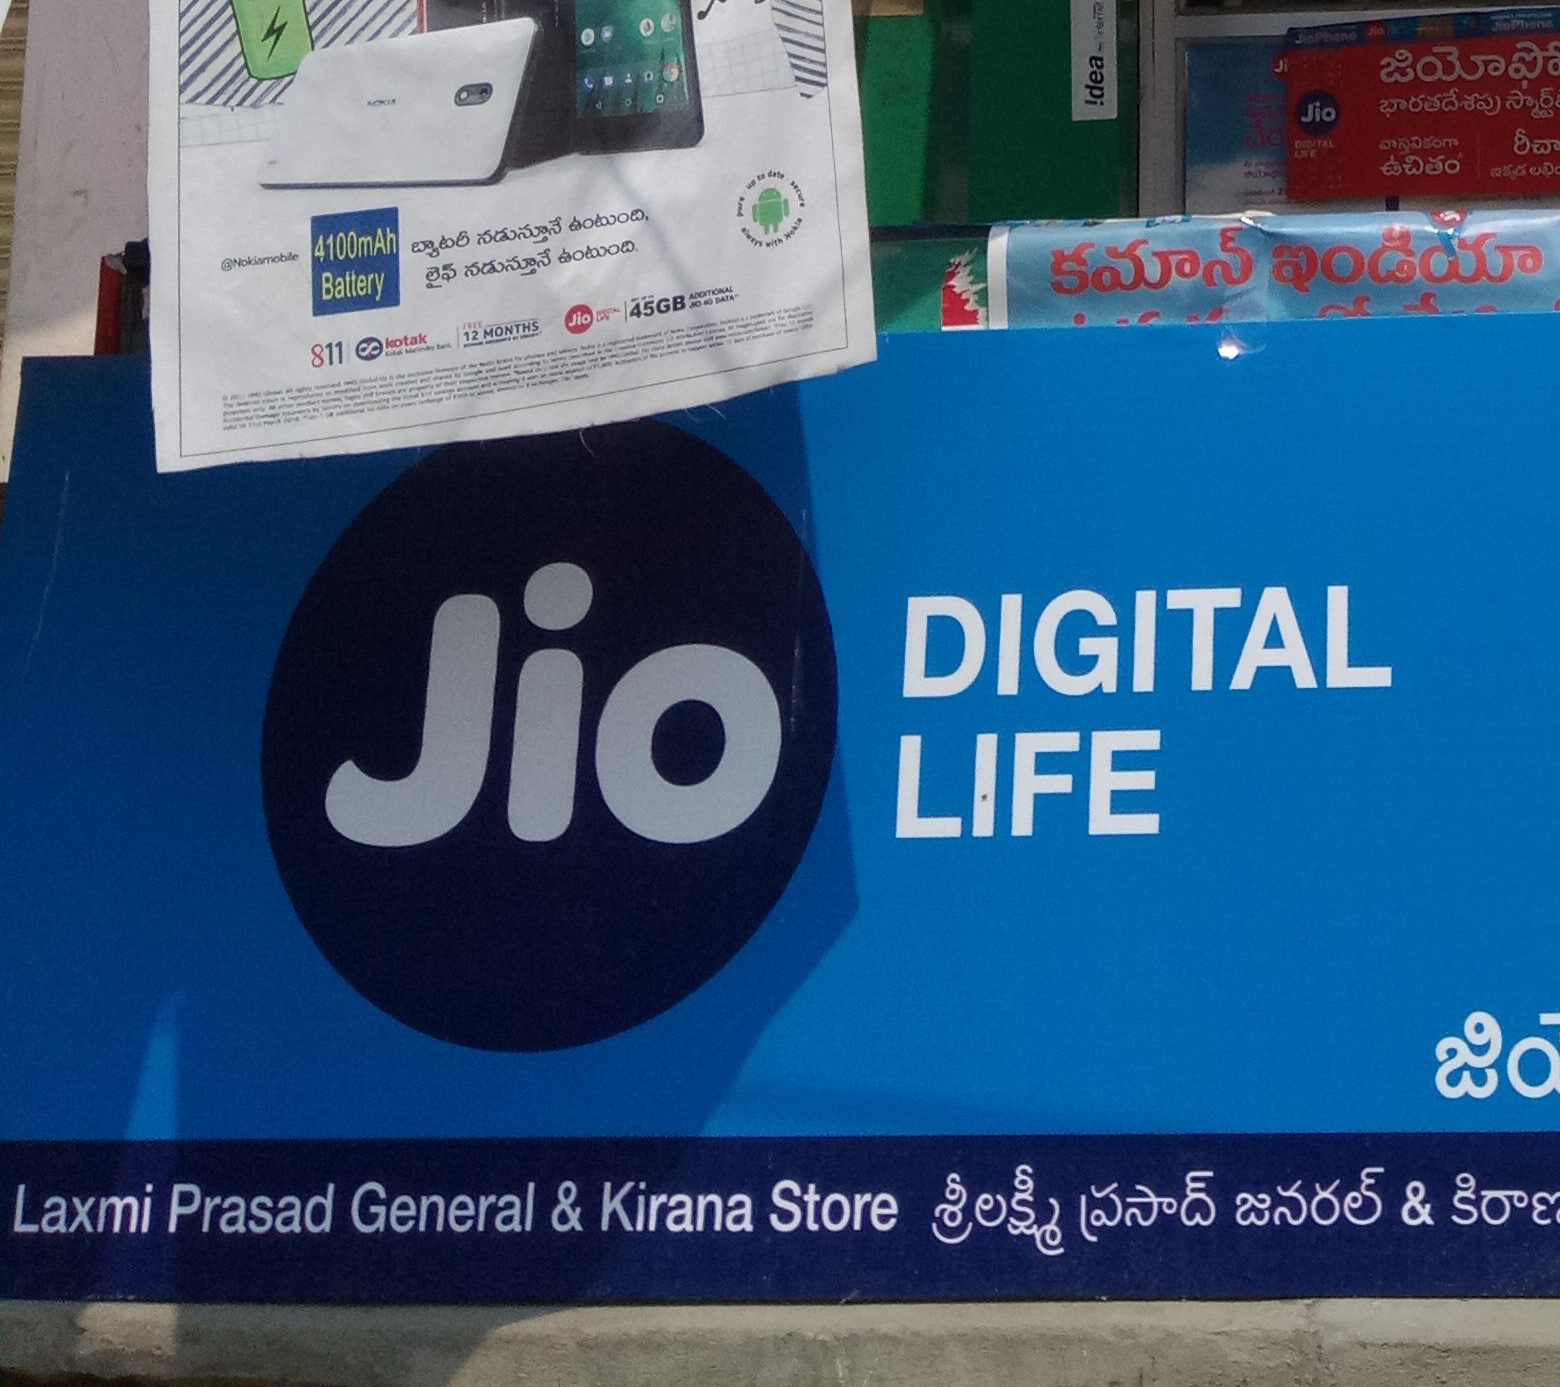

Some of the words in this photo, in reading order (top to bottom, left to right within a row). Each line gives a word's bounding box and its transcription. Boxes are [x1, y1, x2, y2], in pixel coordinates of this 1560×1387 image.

[1299, 104, 1336, 126] Jio
[1378, 87, 1501, 117] భారతదేశపు
[767, 168, 785, 180] date
[312, 226, 398, 263] 4100mAh
[1049, 226, 1256, 297] కమాన్
[1271, 223, 1546, 294] ఇండియా
[321, 270, 386, 303] Battery
[688, 285, 735, 301] ADDITIONAL
[567, 311, 592, 328] Jio
[628, 295, 687, 320] 45GB
[385, 332, 428, 350] kotak
[462, 329, 480, 343] 12
[482, 319, 540, 341] MONTHS
[310, 340, 344, 369] 811
[901, 583, 1394, 699] DIGITAL
[324, 560, 783, 848] Jio
[894, 727, 1163, 839] LIFE
[13, 1181, 154, 1235] Laxmi
[168, 1180, 335, 1234] Prasad
[349, 1180, 536, 1234] General
[551, 1179, 585, 1233] &
[600, 1180, 755, 1233] Kirana
[768, 1178, 899, 1233] Store
[1079, 1169, 1218, 1245] ప్రసాద్
[1234, 1165, 1387, 1228] జనరల్
[1402, 1179, 1436, 1226] &
